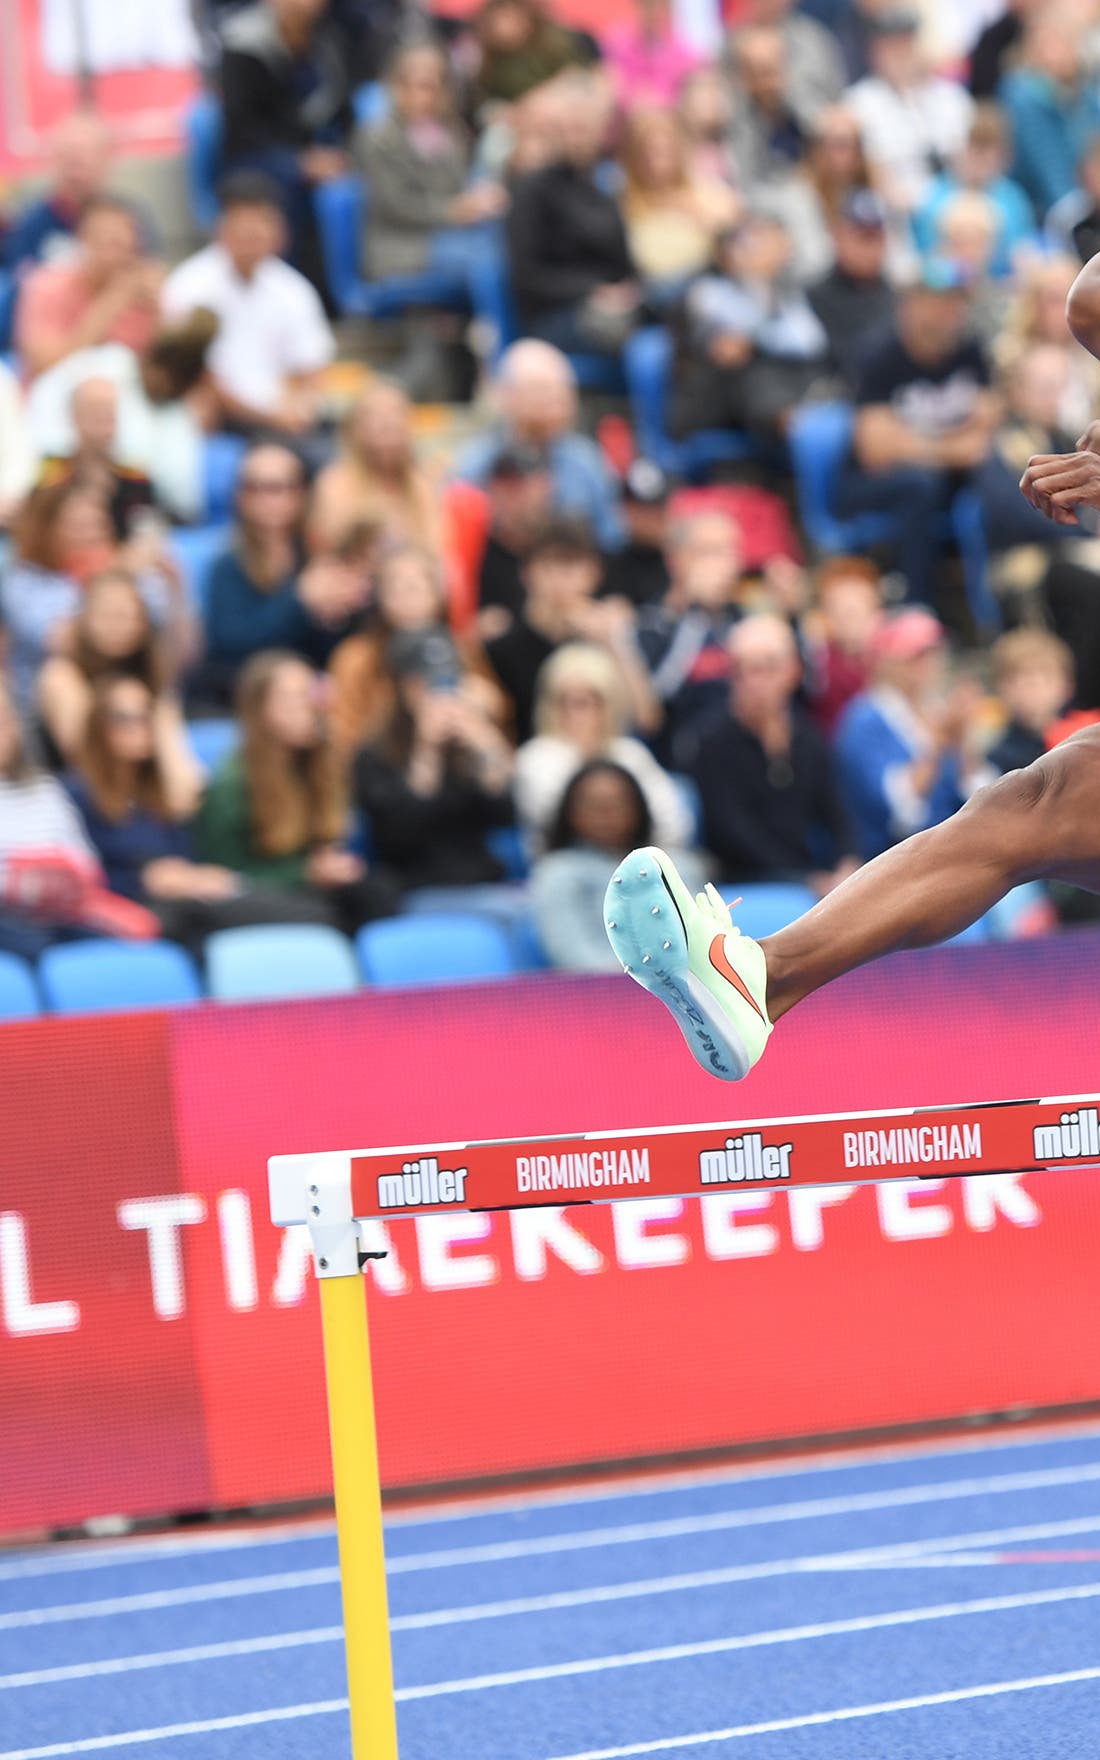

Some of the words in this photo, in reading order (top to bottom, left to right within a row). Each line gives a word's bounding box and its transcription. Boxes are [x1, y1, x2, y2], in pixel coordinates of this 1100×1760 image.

[377, 1157, 469, 1208] müller
[516, 1148, 651, 1192] BIRMINGHAM
[699, 1132, 794, 1184] müller
[843, 1123, 983, 1167] BIRMINGHAM
